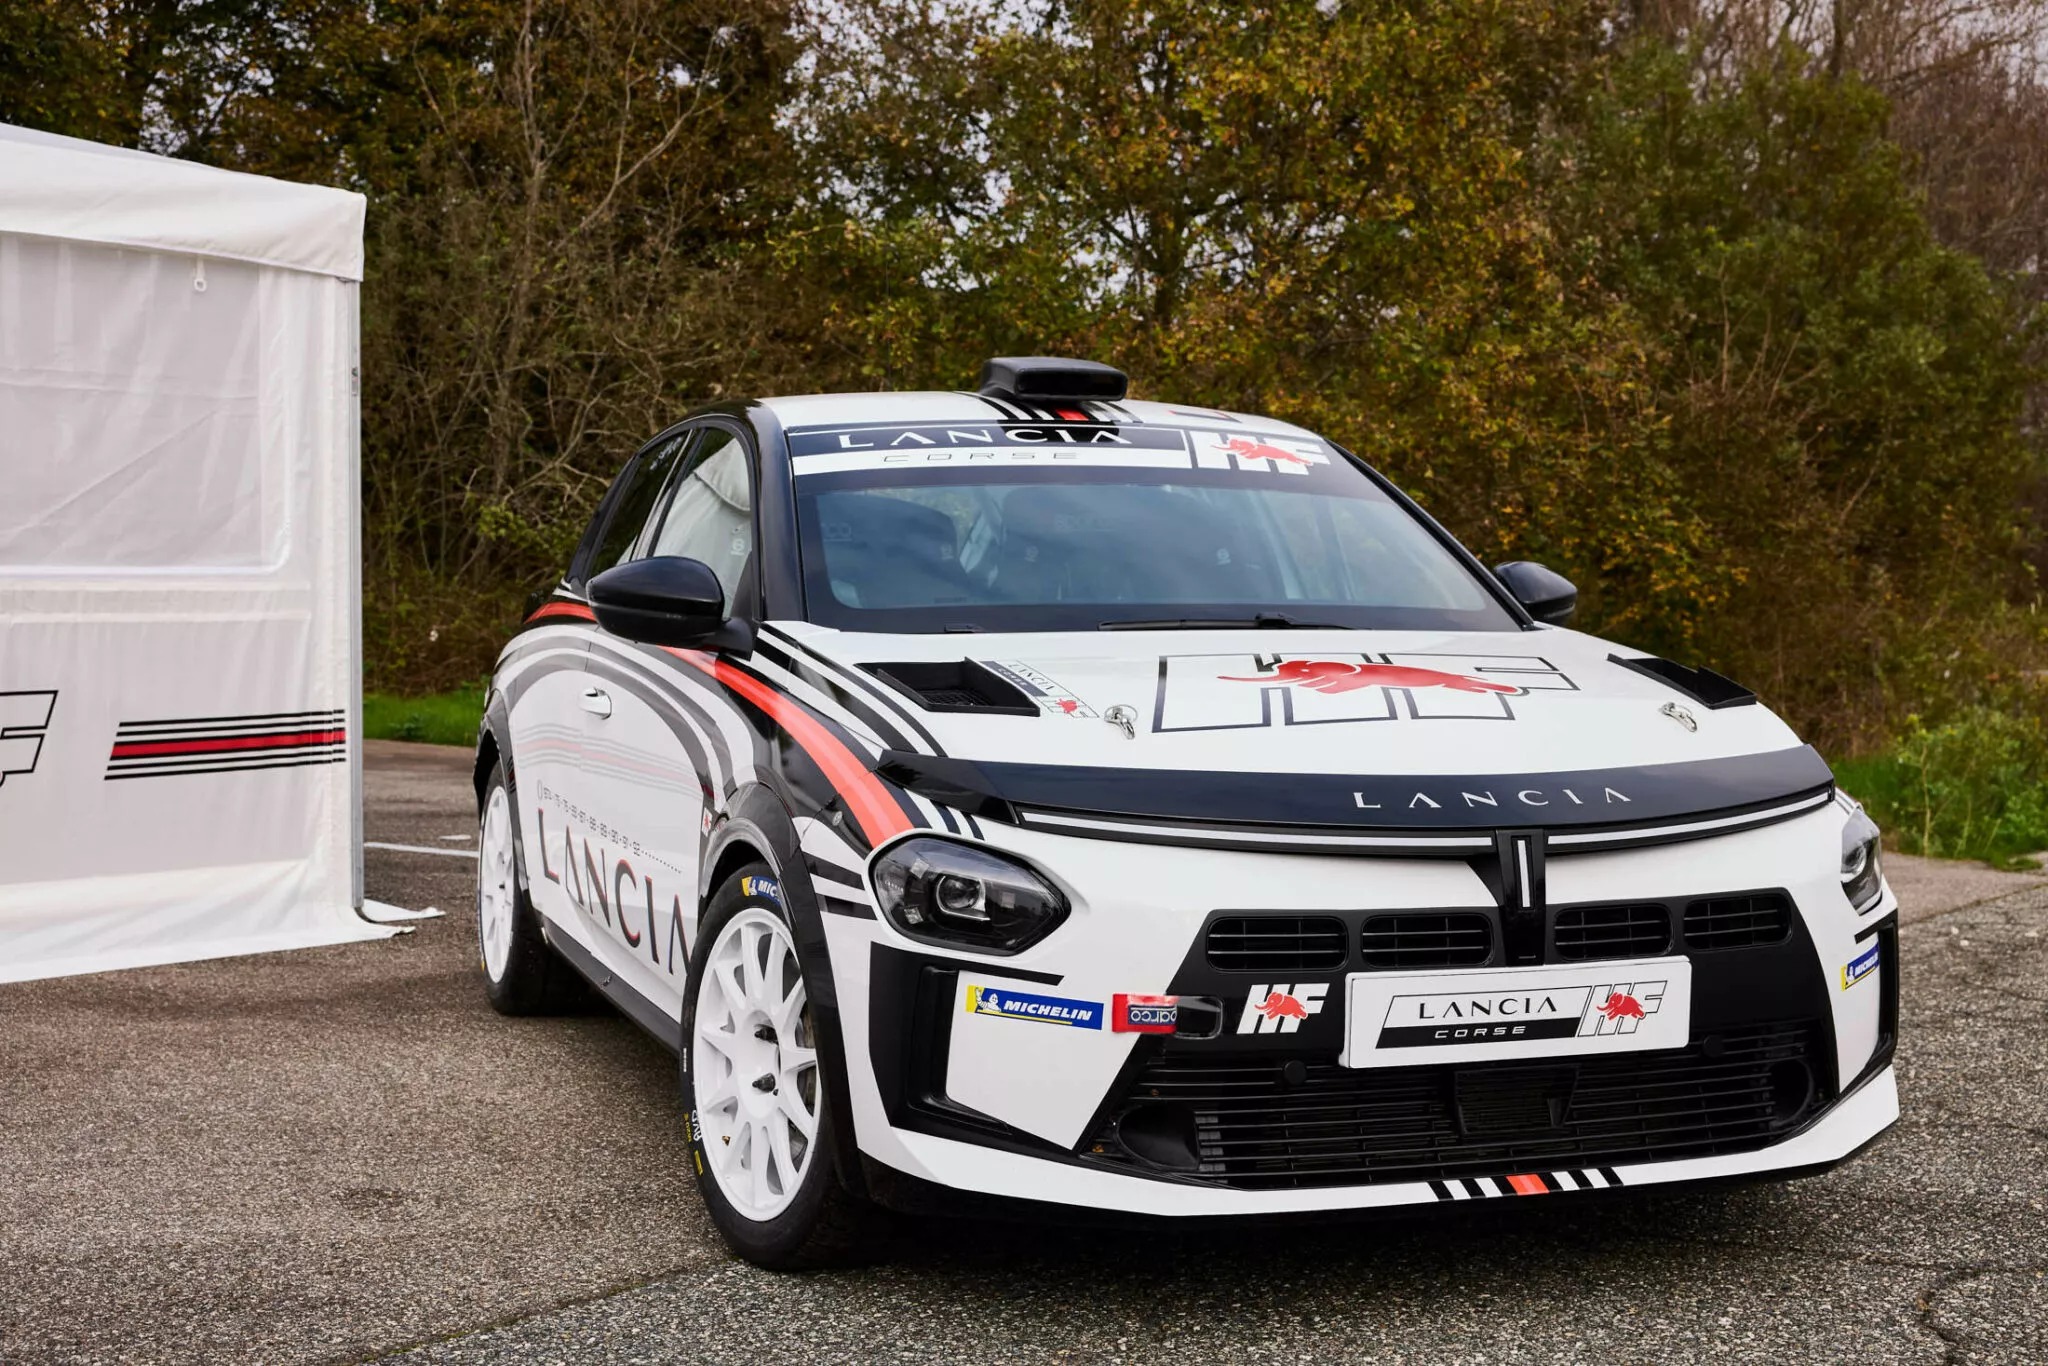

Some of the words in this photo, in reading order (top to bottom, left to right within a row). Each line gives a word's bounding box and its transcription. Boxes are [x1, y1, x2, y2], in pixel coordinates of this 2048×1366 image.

[838, 429, 1133, 448] LANCIA
[884, 453, 1078, 463] CORSE
[1353, 787, 1632, 808] LANCIA
[538, 808, 692, 976] LANCIA
[1003, 1000, 1093, 1021] MICHELIN
[1130, 1006, 1177, 1025] parco
[1236, 983, 1330, 1034] HF
[1419, 996, 1557, 1019] LANCIA
[1434, 1025, 1526, 1039] CORSE
